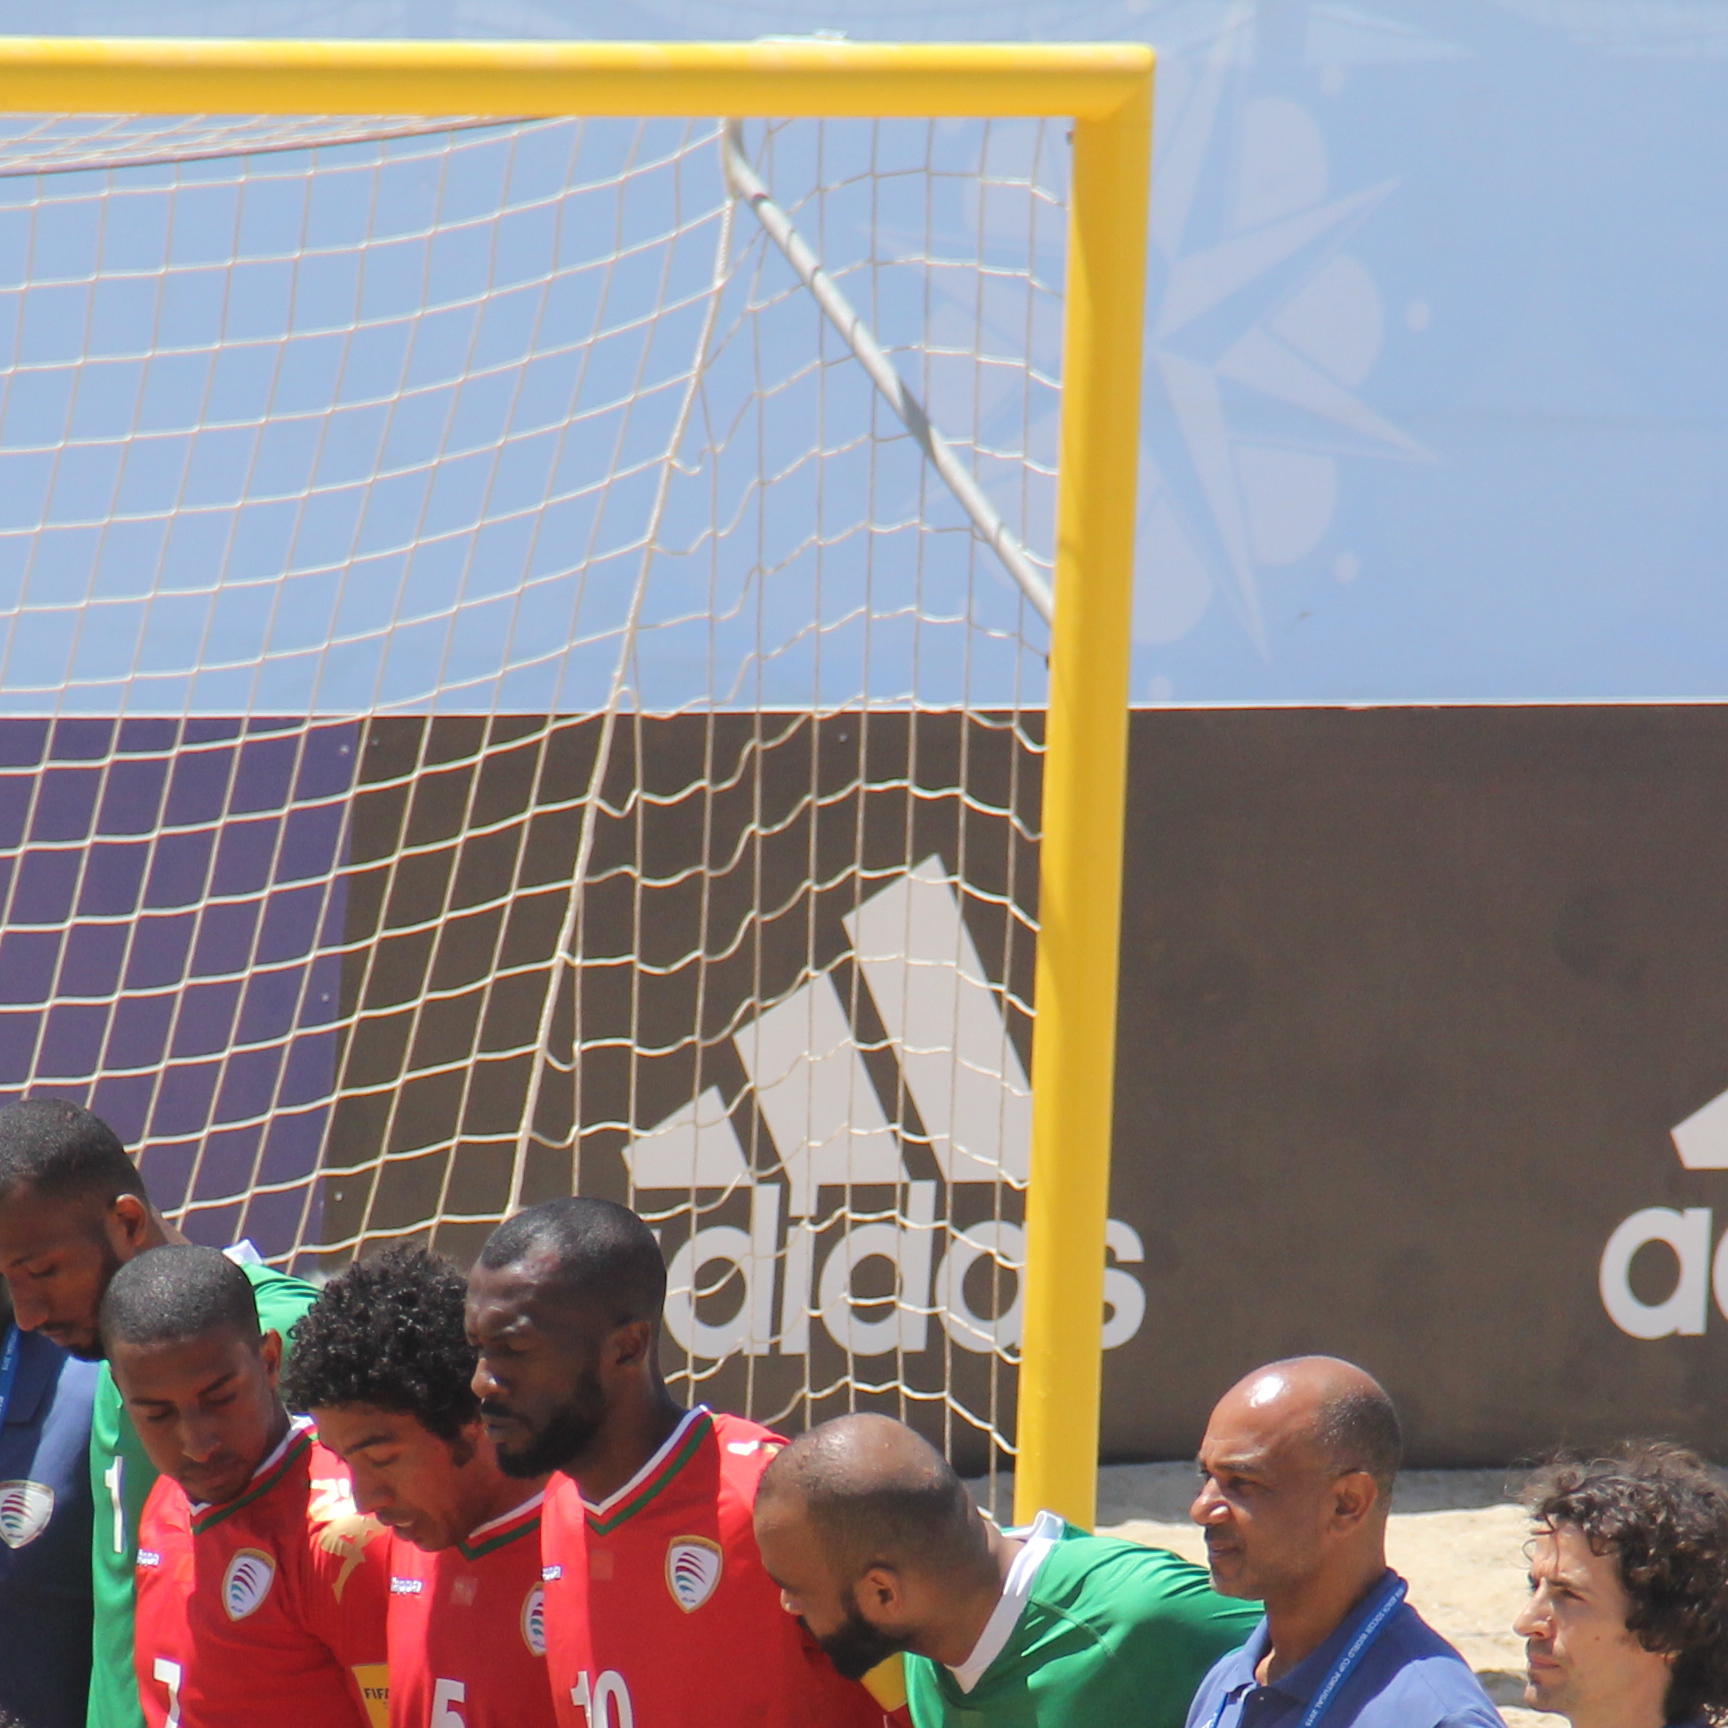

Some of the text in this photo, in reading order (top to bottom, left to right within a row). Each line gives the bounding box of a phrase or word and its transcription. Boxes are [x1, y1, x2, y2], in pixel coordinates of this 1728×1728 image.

[653, 1180, 1146, 1358] dida
[105, 1456, 122, 1553] 1
[1347, 1632, 1368, 1658] WORLD
[1338, 1657, 1351, 1673] CUP
[1314, 1671, 1341, 1708] PORTUGAL
[1304, 1708, 1318, 1727] 2015
